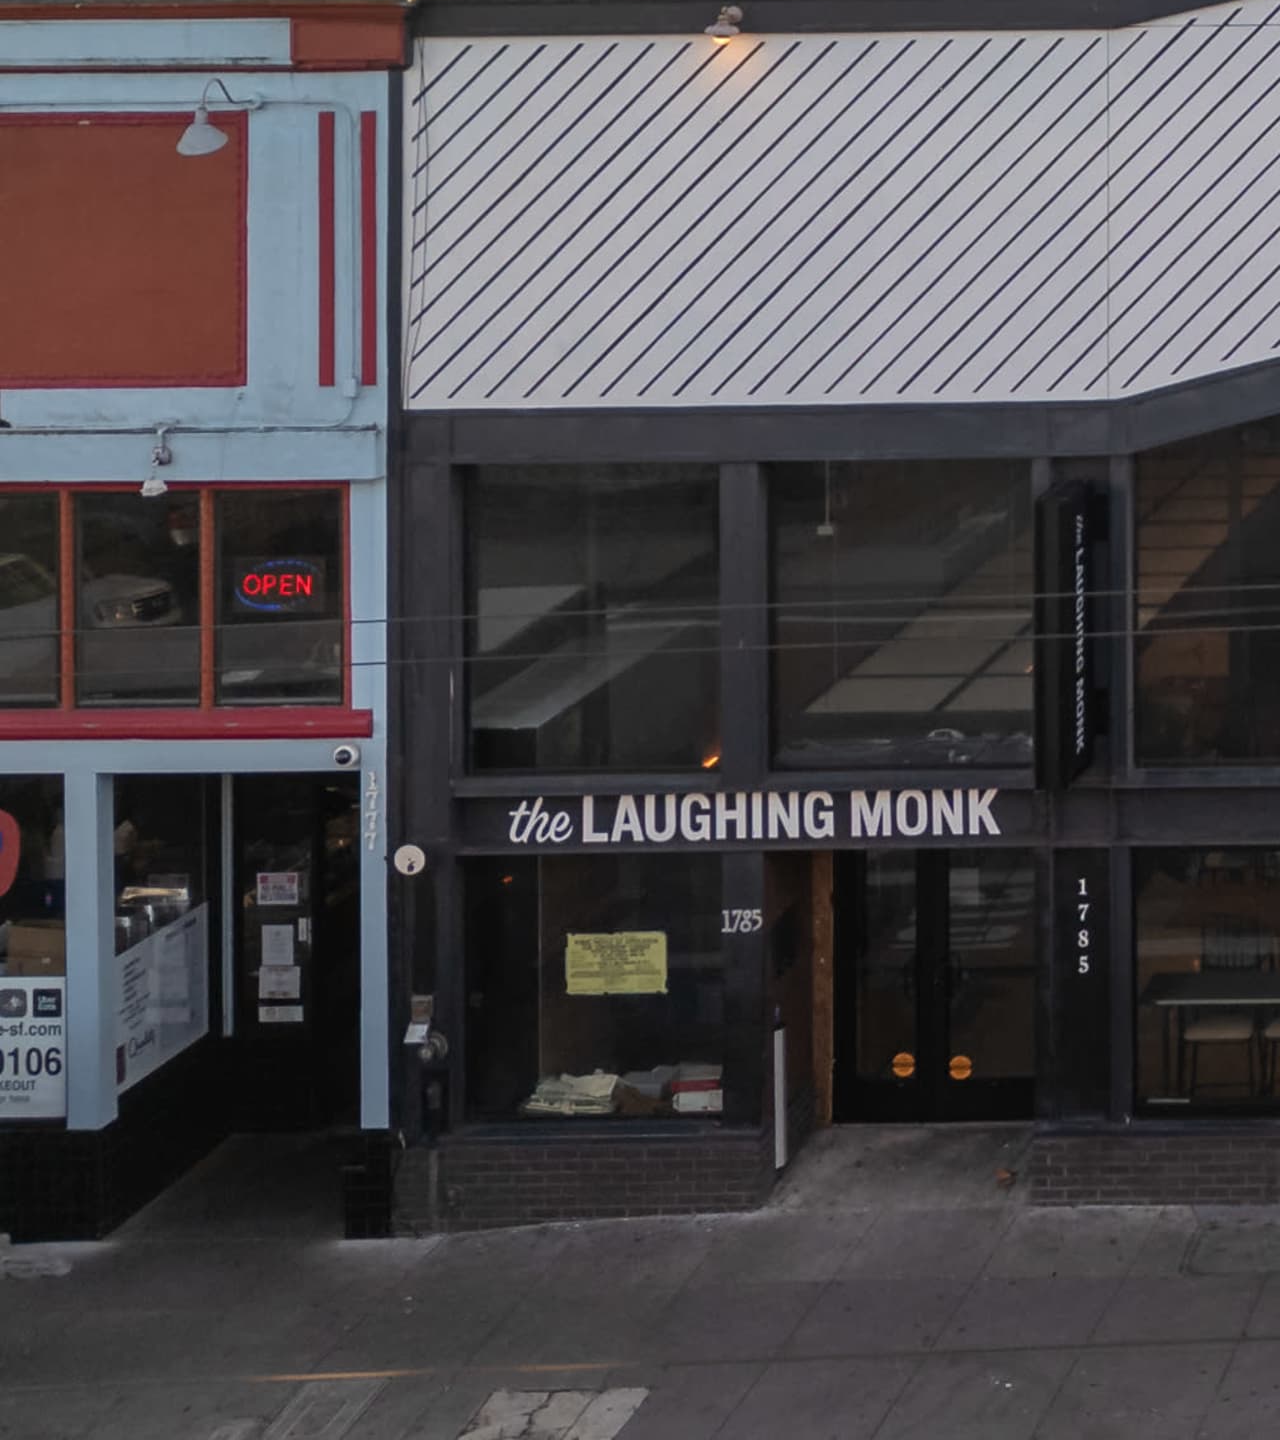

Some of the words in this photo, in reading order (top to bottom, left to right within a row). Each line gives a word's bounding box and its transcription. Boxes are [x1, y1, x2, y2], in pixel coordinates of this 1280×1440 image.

[242, 573, 314, 597] OPEN
[364, 770, 378, 852] 1777
[508, 796, 574, 844] the
[581, 790, 836, 844] LAUGHING
[849, 788, 1001, 838] MONK
[721, 908, 764, 933] 1785
[1077, 877, 1090, 974] 1785
[0, 1047, 62, 1076] 106
